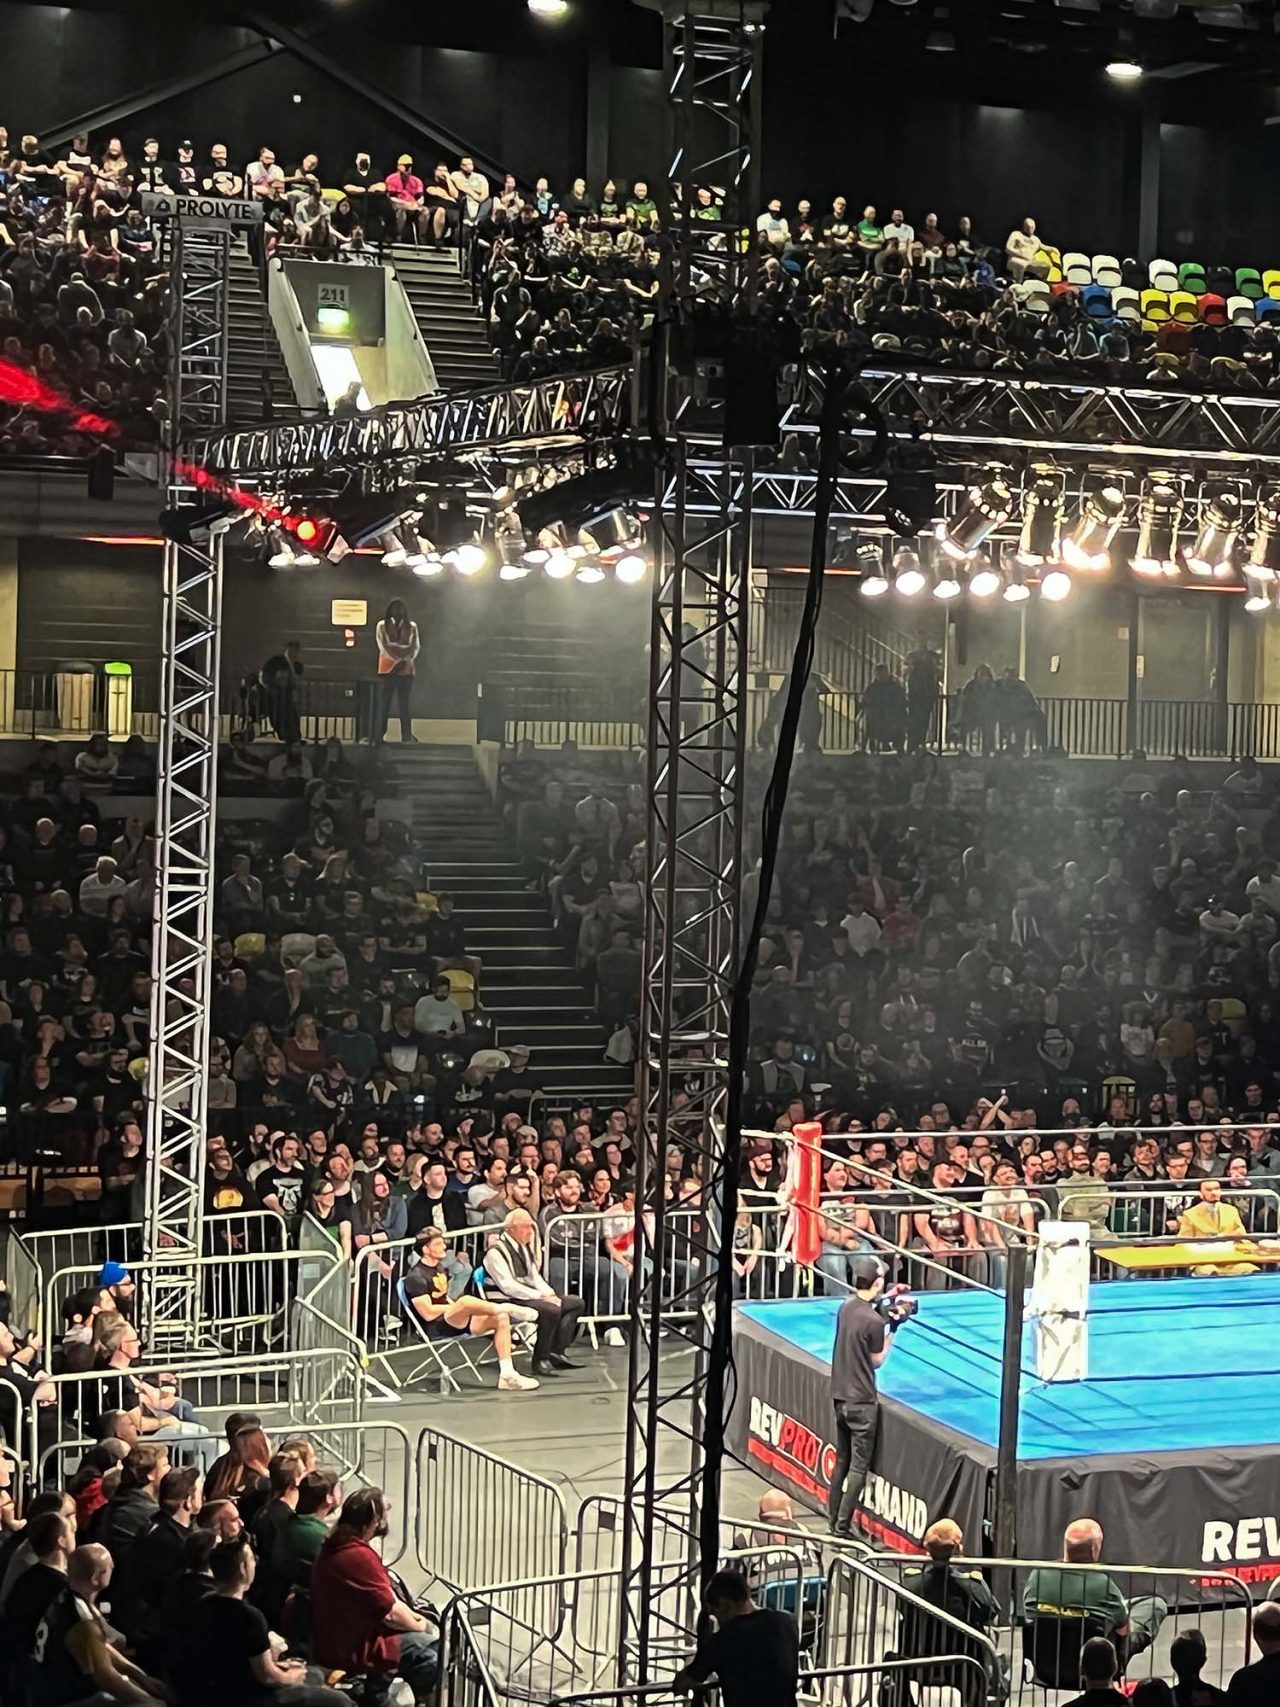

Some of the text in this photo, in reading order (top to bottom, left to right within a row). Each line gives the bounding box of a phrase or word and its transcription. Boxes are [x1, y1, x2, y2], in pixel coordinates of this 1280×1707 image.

[176, 199, 252, 219] PROLYTE
[320, 288, 345, 302] 211
[749, 1396, 817, 1468] REVPRO
[858, 1472, 927, 1540] EMAND
